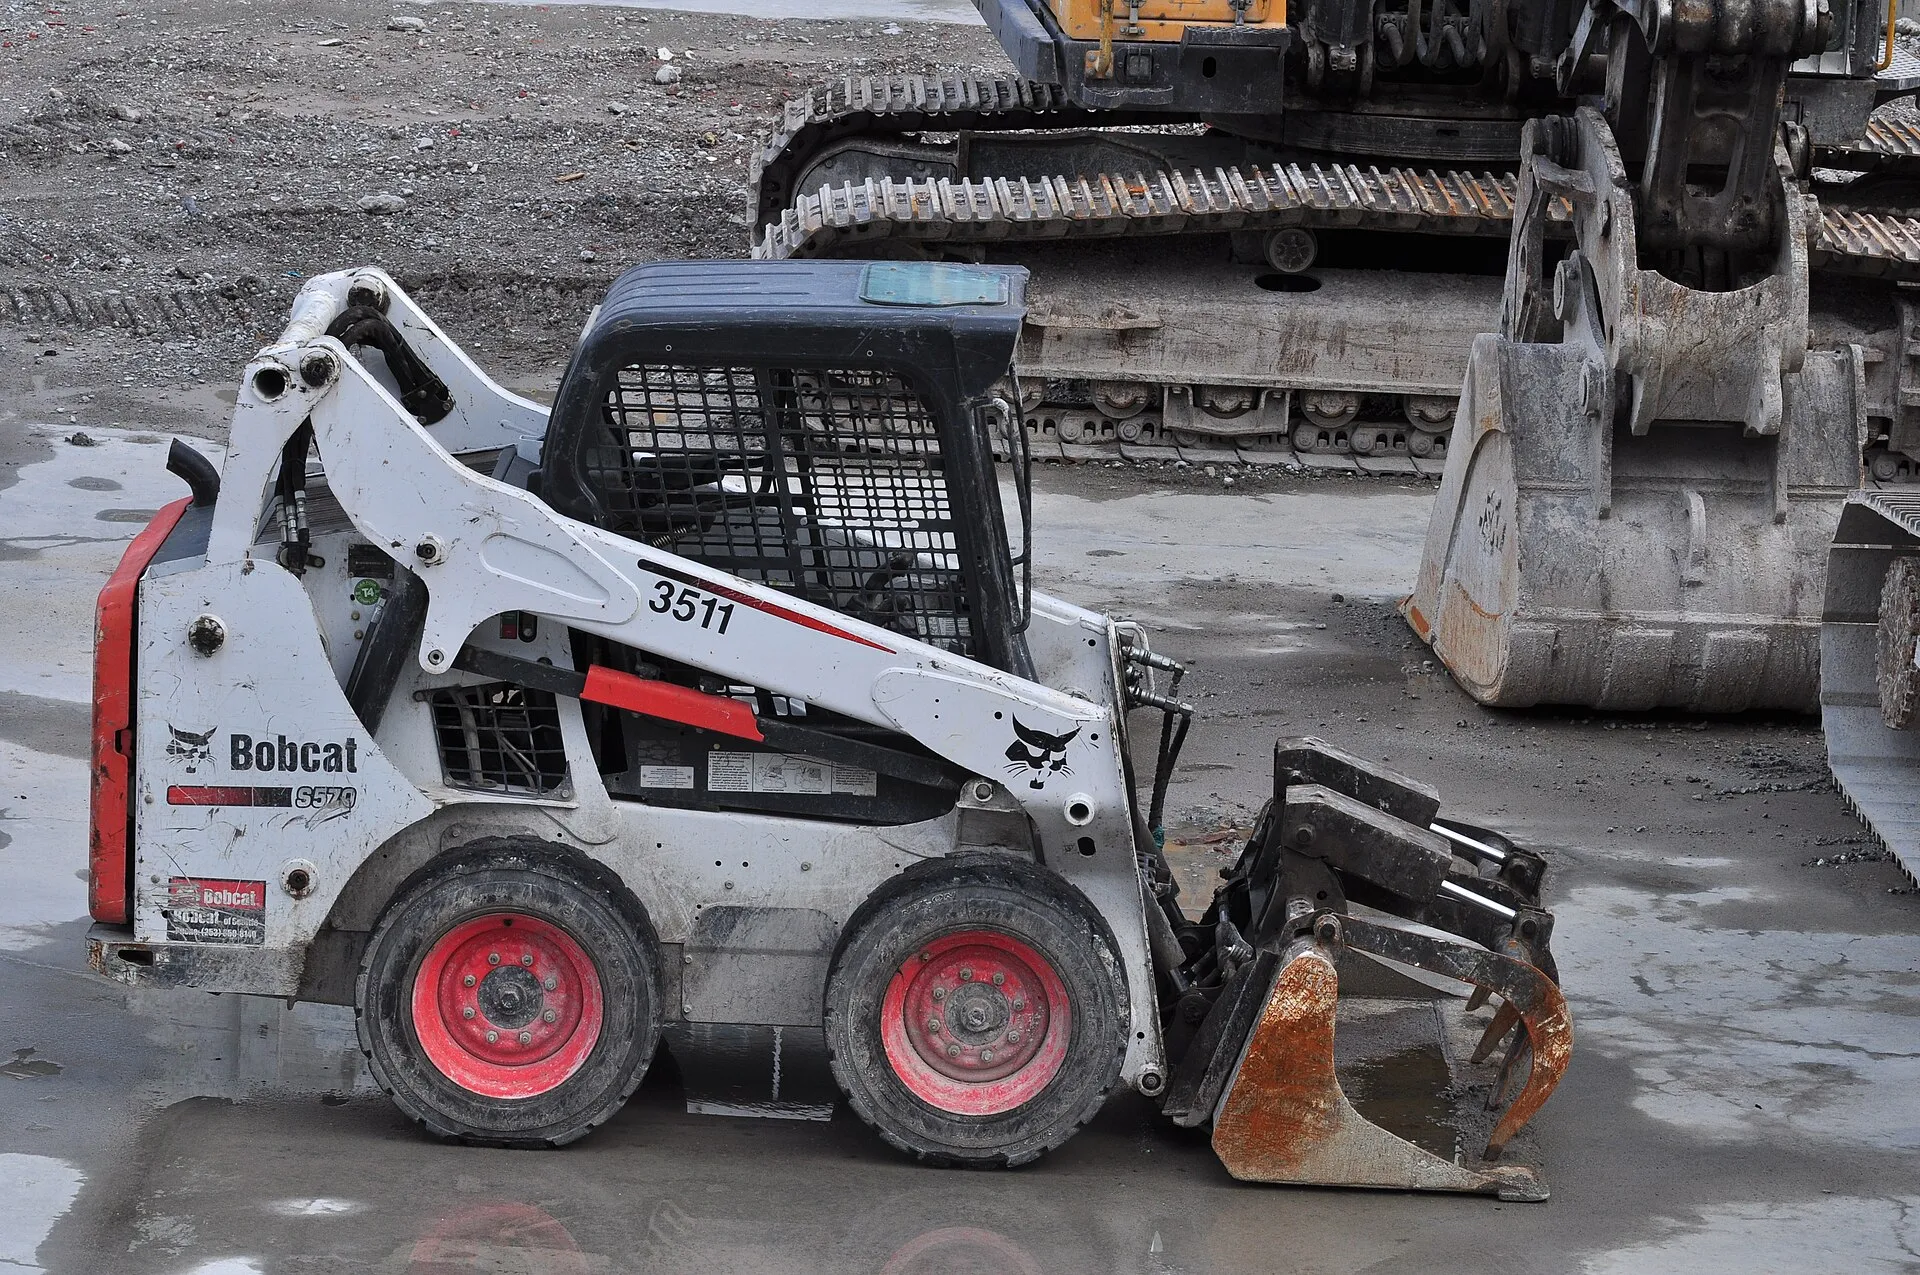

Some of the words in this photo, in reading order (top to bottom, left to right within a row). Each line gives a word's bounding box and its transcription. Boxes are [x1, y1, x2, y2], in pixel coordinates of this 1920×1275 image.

[361, 587, 375, 598] T4
[648, 580, 735, 635] 3511
[230, 734, 358, 773] Bobcat
[295, 786, 357, 809] S570
[204, 889, 256, 906] Bobcat
[173, 910, 220, 924] Bobcat
[223, 917, 231, 926] of
